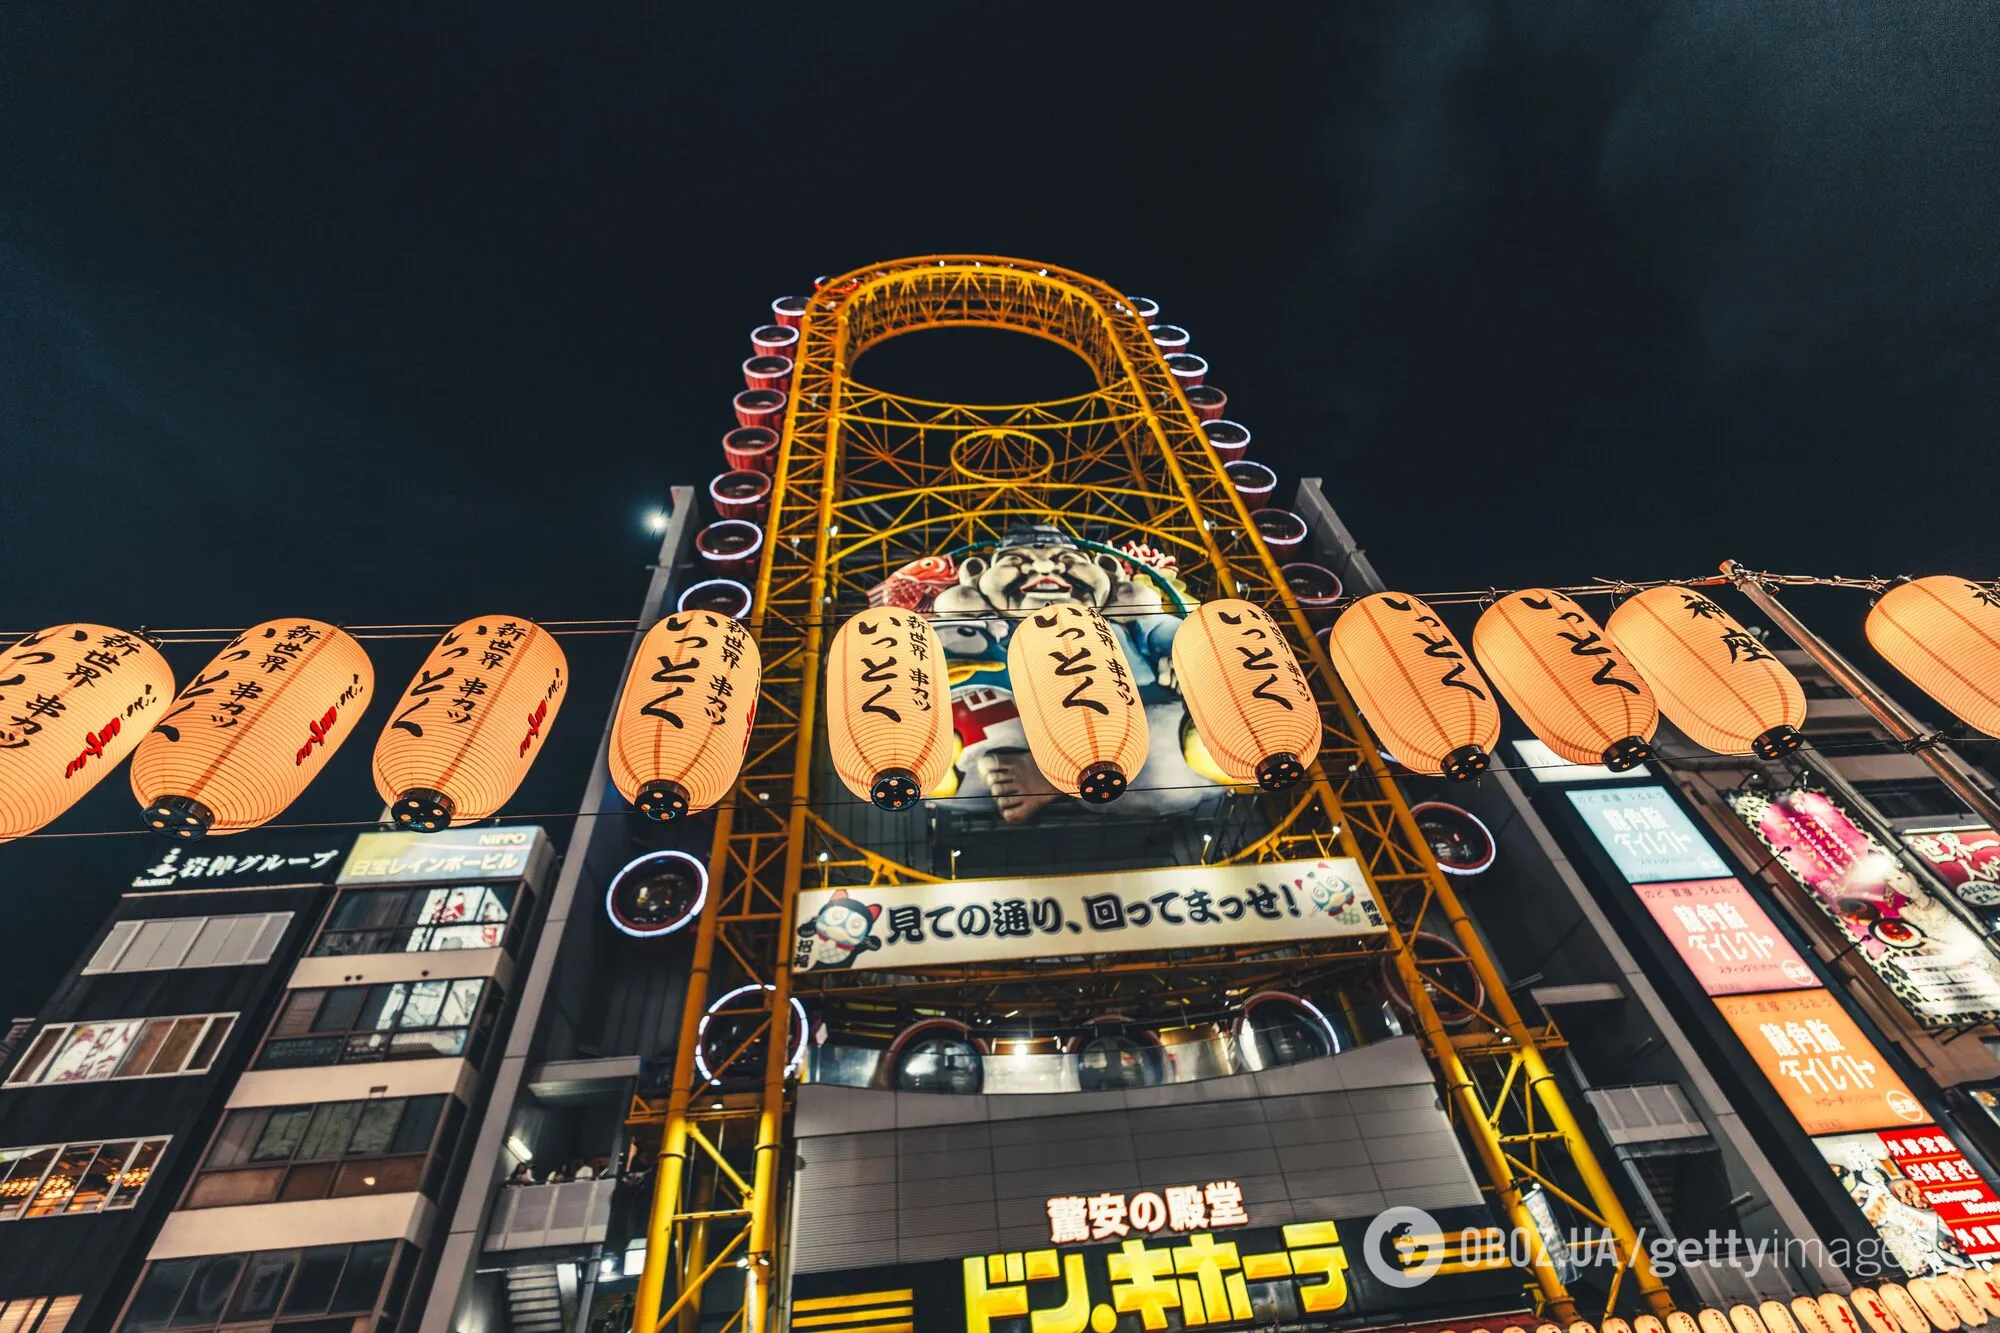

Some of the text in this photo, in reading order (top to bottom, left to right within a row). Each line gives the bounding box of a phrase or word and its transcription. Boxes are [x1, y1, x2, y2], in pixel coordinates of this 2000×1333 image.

[62, 632, 143, 689] 新世界
[152, 627, 277, 743] いっとく
[210, 624, 322, 729] 新世界 串カツ
[391, 624, 488, 738] いっとく
[446, 621, 527, 725] 新世界 串カツ
[640, 615, 719, 729] いっとく
[720, 619, 750, 670] 新世界
[859, 616, 902, 723] いっとく
[905, 615, 932, 712] 新世界 串カツ
[1034, 606, 1110, 716] いっとく
[1105, 658, 1135, 706] 串カツ
[1218, 608, 1294, 711] いっとく
[0, 693, 67, 749] 串カツ
[704, 674, 734, 726] 串カツ
[1046, 1180, 1249, 1244] 驚安の殿堂
[1923, 1188, 1984, 1205] Exchange
